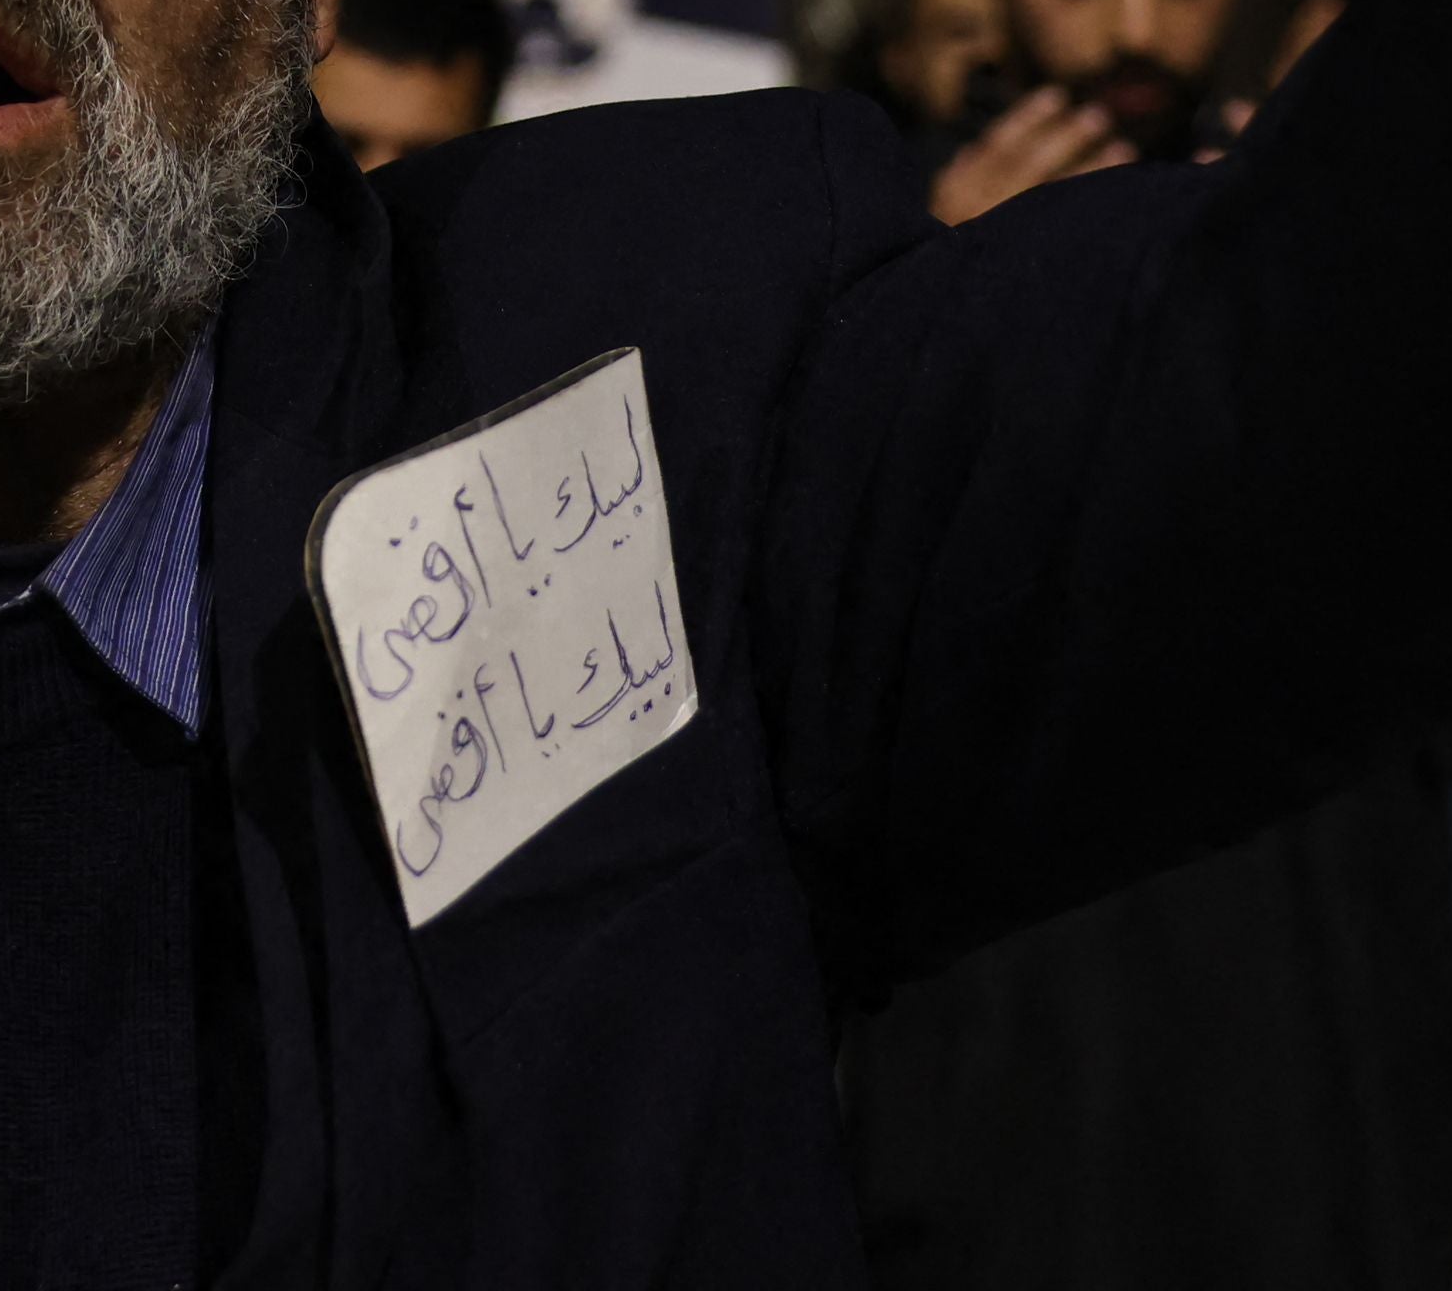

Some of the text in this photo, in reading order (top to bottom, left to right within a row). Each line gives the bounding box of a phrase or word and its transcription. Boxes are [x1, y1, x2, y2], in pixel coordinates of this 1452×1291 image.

[357, 394, 643, 701] لبيك يا أقصى
[397, 579, 674, 877] لبيك يا أقصى
